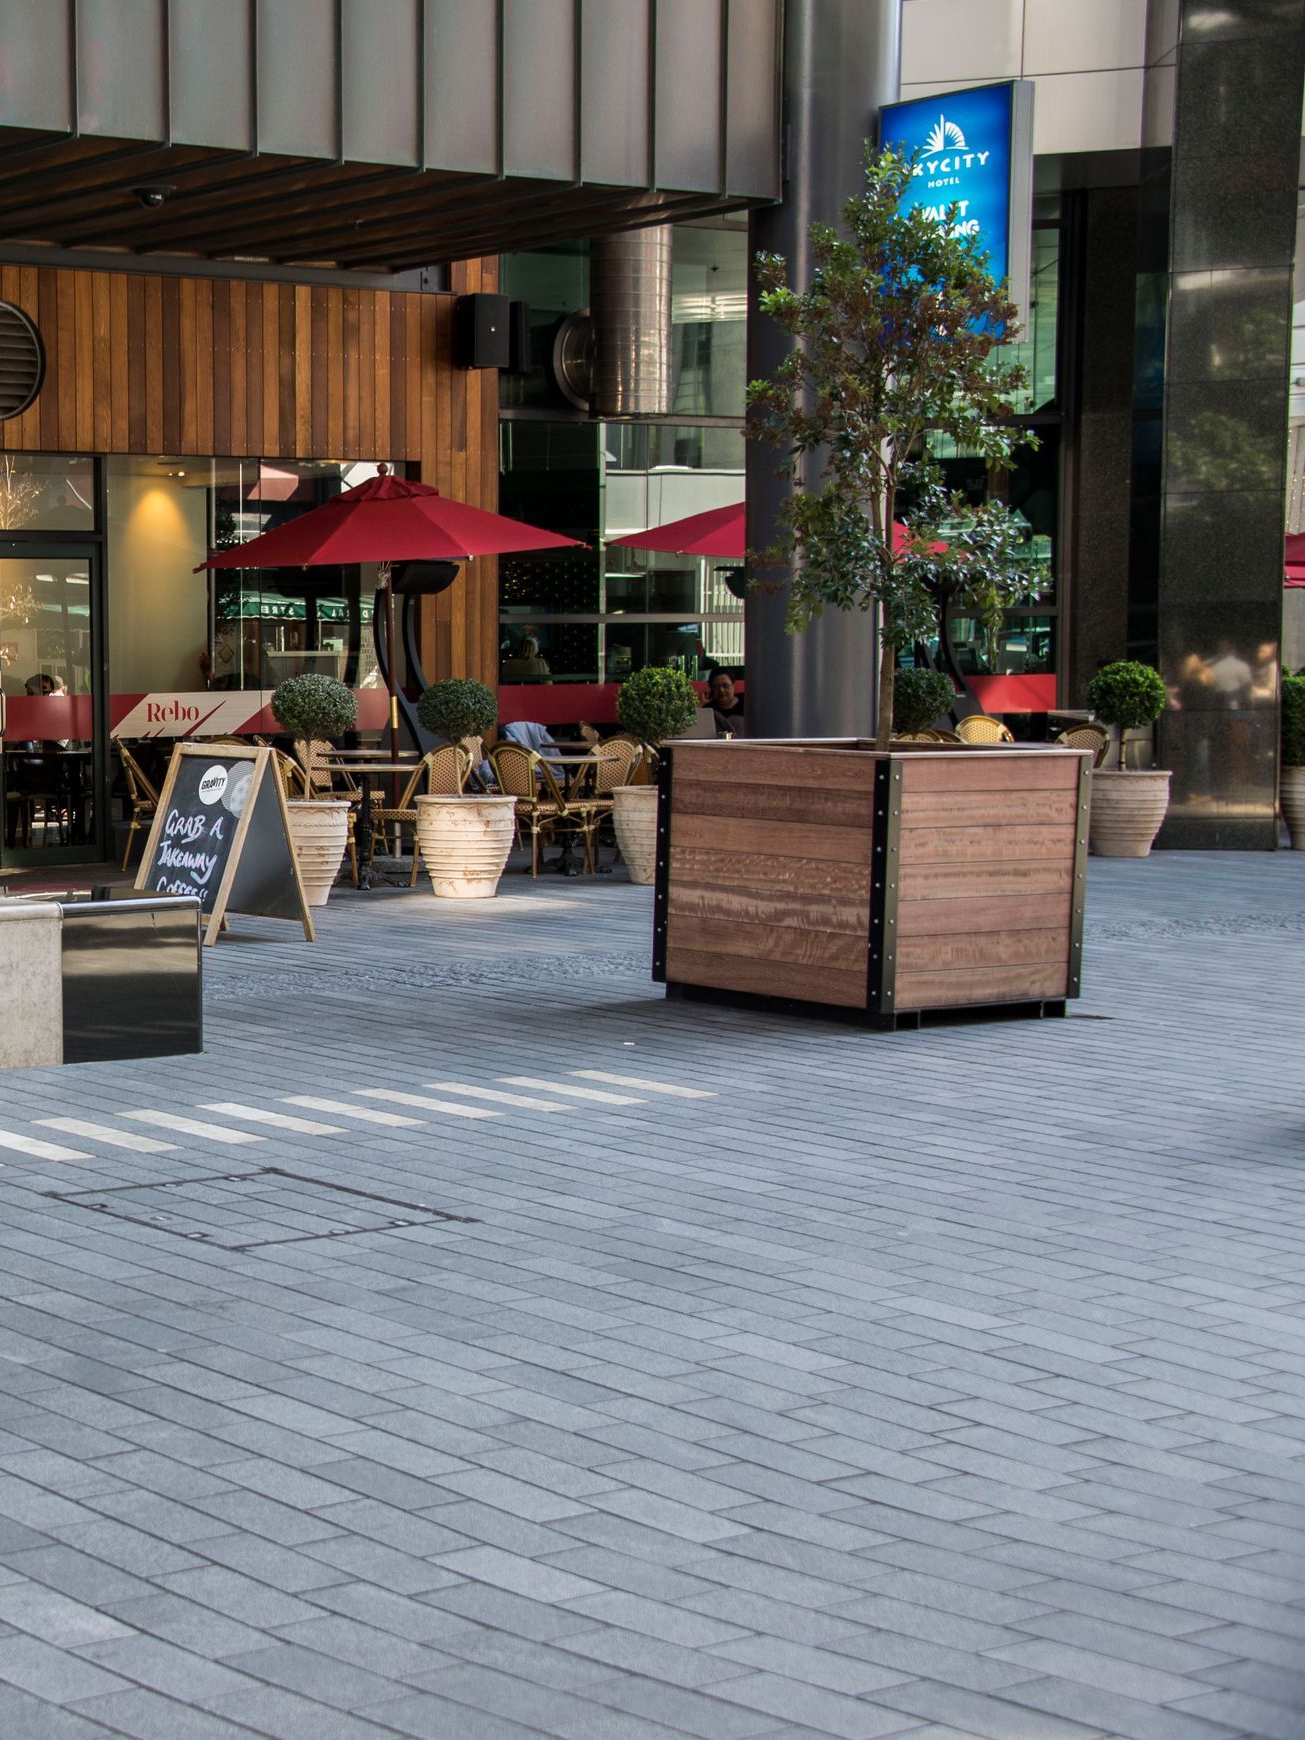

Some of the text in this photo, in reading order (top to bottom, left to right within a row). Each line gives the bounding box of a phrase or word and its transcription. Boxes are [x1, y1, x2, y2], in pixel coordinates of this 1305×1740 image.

[911, 151, 990, 177] KYCITY
[927, 177, 960, 189] HOTEL
[921, 200, 969, 223] VALT
[147, 700, 200, 723] Rebo
[201, 777, 227, 790] GRAVITY
[165, 808, 224, 844] GRAB A
[157, 840, 218, 885] TAKEAWAY
